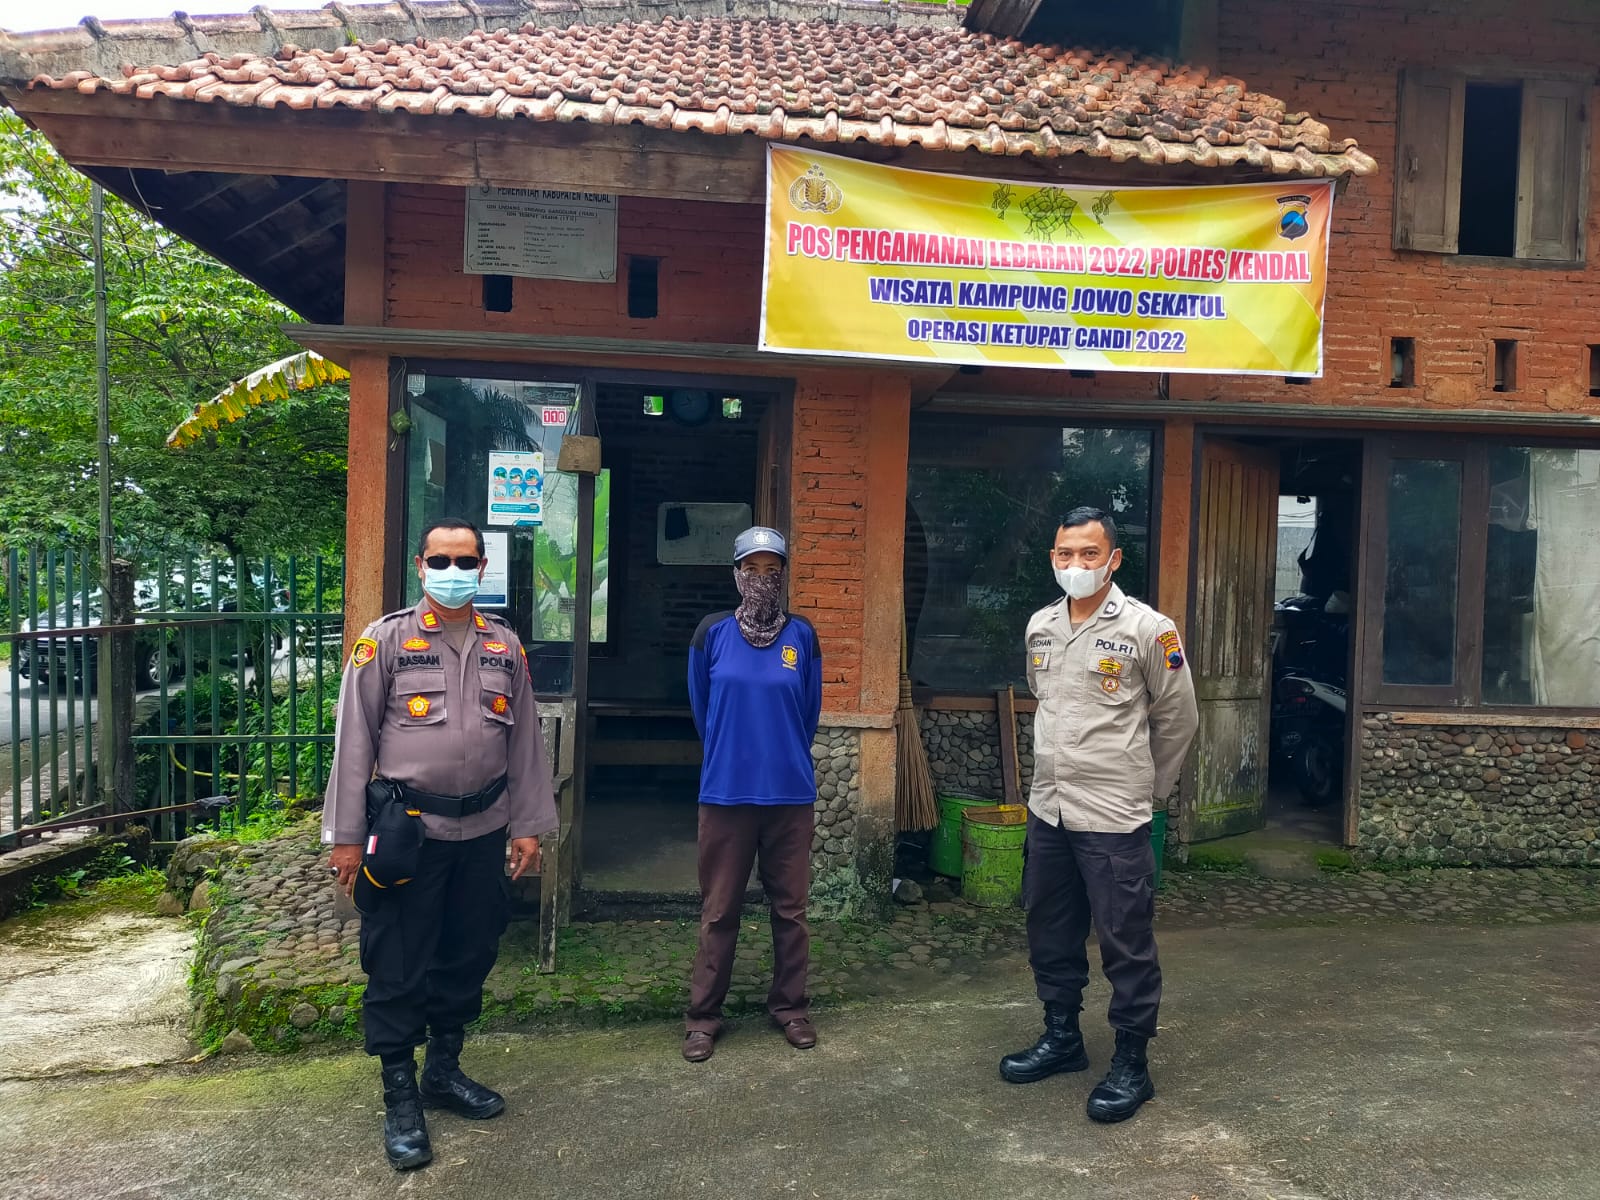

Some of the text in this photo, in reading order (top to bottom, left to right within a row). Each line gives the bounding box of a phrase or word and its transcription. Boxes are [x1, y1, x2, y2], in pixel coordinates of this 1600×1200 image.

[543, 190, 581, 201] KABUPATEN
[787, 222, 1311, 281] POS PENGAMANAN LEBARAN 2022 POLRES KENDAL
[870, 278, 1226, 318] WISATA KAMPUNG JOWO SEKATUL
[907, 318, 1186, 351] OPERASI KETUPAT CANDI 2022
[544, 411, 566, 423] 110
[1095, 638, 1134, 655] POLRI
[480, 656, 514, 670] POLRI
